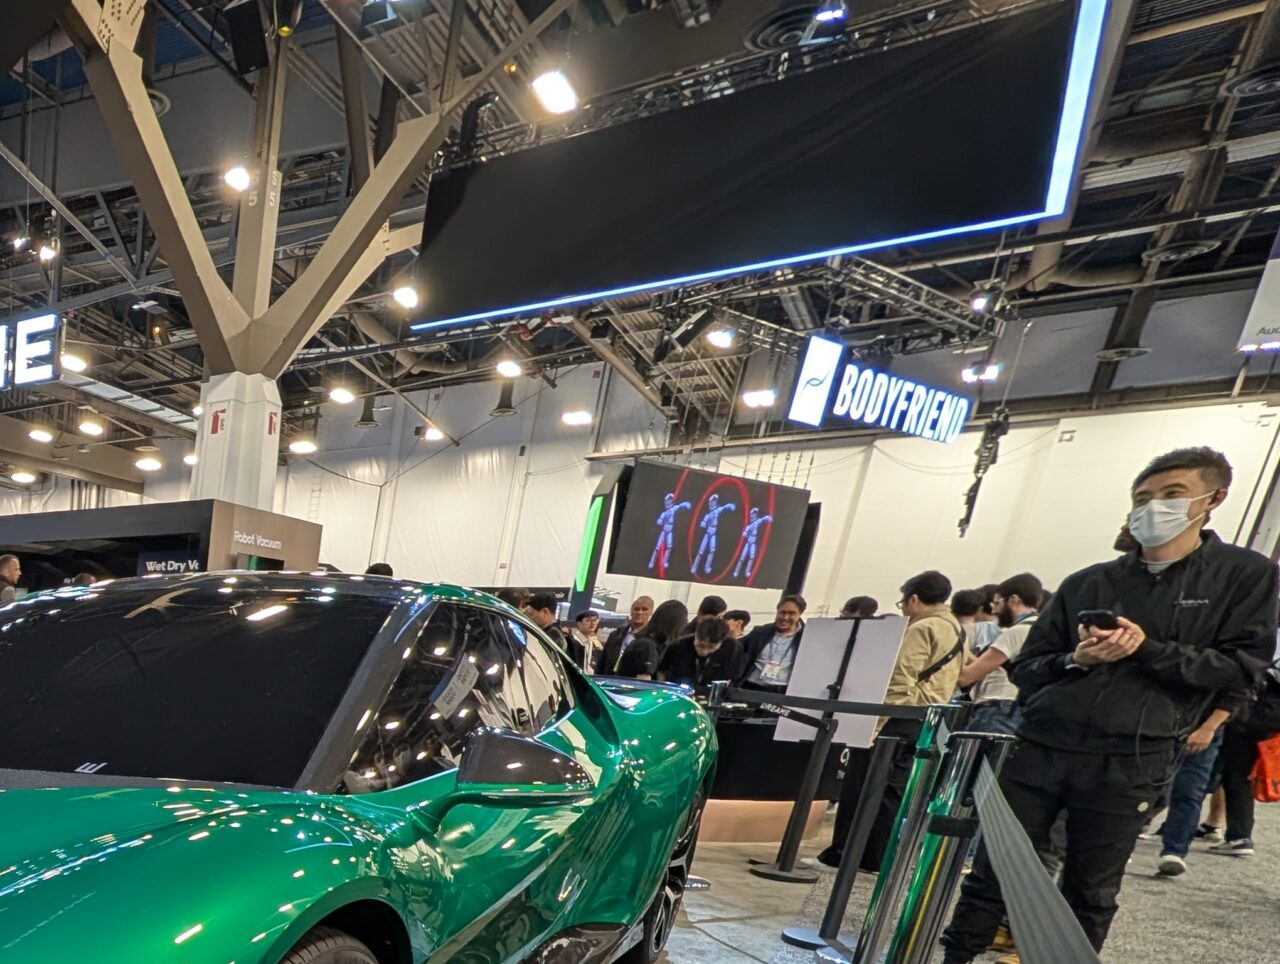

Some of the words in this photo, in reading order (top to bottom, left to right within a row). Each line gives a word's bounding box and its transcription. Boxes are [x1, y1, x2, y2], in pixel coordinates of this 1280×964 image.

[833, 364, 969, 444] BODYFRIEND
[234, 530, 255, 545] Robot
[255, 534, 282, 549] Vacuum
[146, 561, 166, 571] Wet
[167, 561, 186, 572] Dry
[760, 703, 791, 717] DREAME
